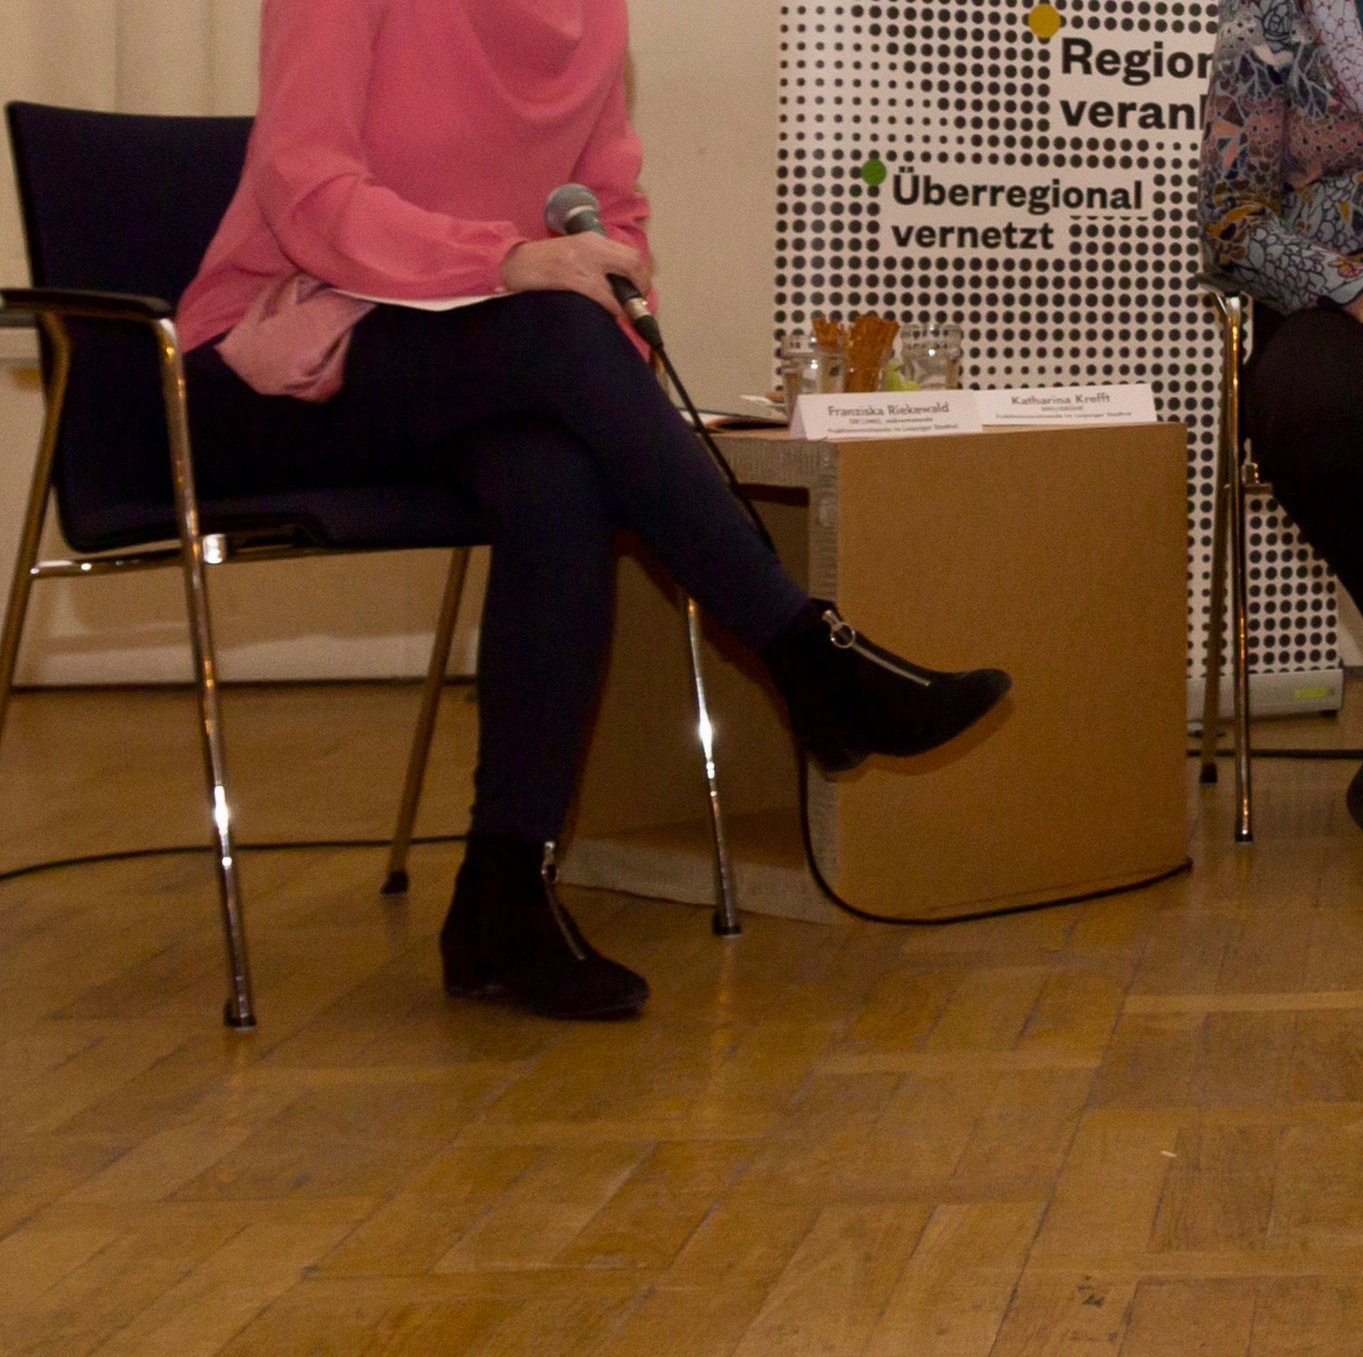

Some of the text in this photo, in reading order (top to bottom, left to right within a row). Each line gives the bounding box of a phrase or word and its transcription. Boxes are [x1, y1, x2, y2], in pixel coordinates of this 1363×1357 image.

[892, 166, 1143, 216] Überregional
[891, 223, 1054, 250] vernetzt
[827, 400, 950, 417] Franziska Riekewald
[1010, 391, 1111, 405] Katharina Krefft
